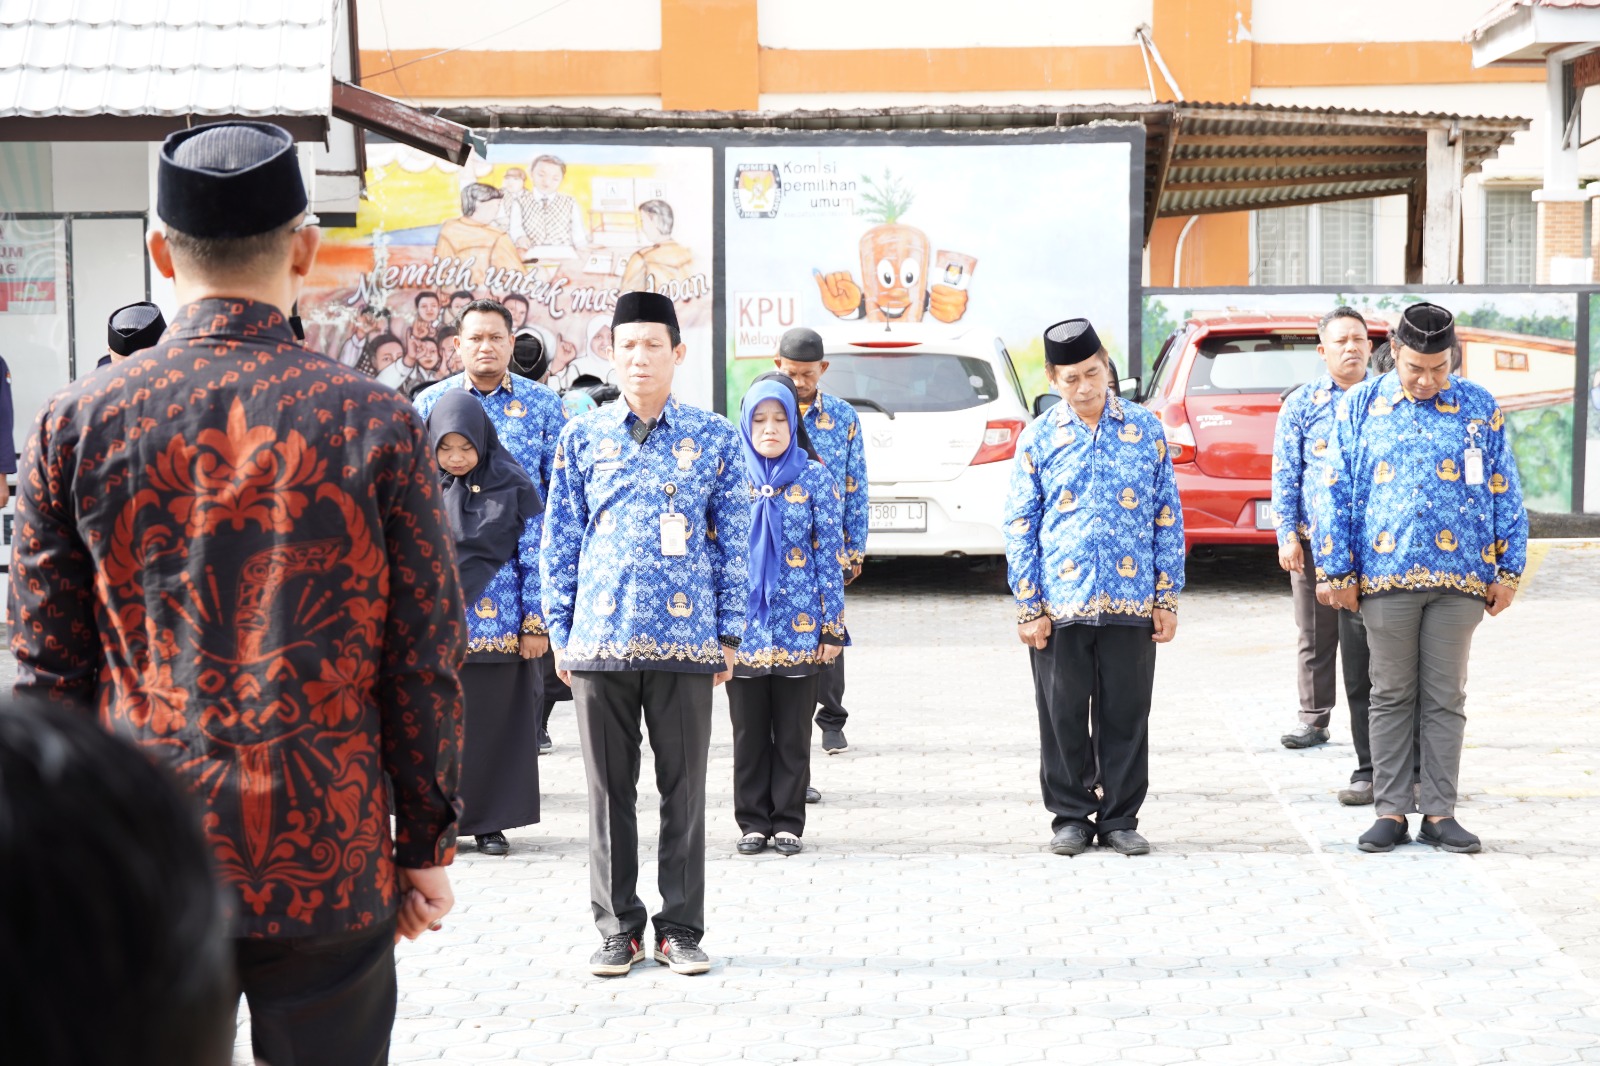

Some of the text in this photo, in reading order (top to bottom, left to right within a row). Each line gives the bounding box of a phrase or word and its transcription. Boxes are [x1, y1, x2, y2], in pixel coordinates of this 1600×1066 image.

[783, 154, 836, 174] Komisi
[783, 179, 857, 197] pemilihan
[348, 256, 476, 305] Memilih
[485, 264, 569, 319] untuk
[570, 286, 634, 313] mas
[739, 297, 795, 328] KPU
[739, 331, 782, 349] Melay
[908, 505, 923, 519] LJ
